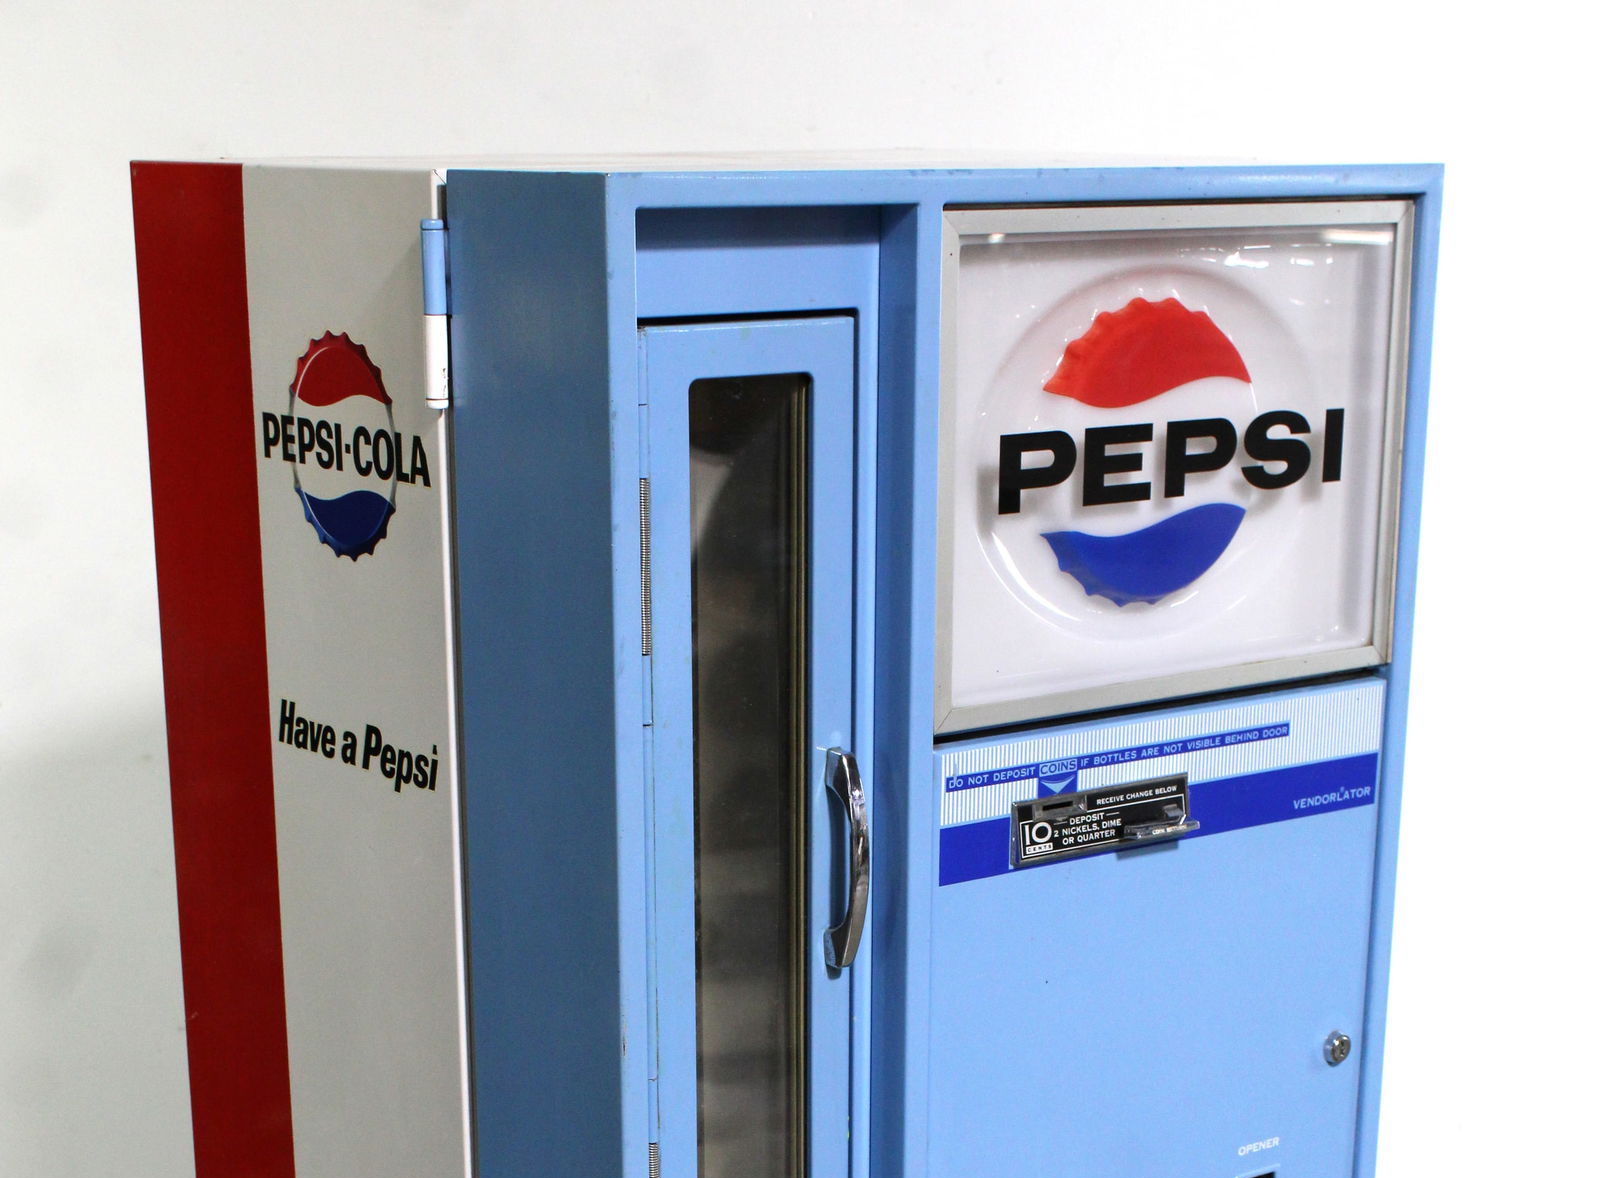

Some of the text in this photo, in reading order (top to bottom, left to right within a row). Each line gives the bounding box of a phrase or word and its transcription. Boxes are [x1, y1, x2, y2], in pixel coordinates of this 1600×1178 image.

[999, 408, 1345, 515] PEPSI
[278, 698, 439, 793] Have a Pepsi
[949, 726, 1288, 789] DO NOT DEPOSIT COINS IF BOTTLES ARE NOT VISIBLE BEHIND DOOR
[1096, 785, 1178, 806] RECEIVE CHANGE BELOW
[1293, 786, 1371, 810] VENDORLATOR
[1054, 830, 1060, 838] 2
[1102, 818, 1122, 830] DIME
[1069, 812, 1105, 825] DEPOSIT
[1024, 821, 1052, 846] 10
[1062, 829, 1116, 846] OR QUARTER
[1238, 1136, 1280, 1156] OPENER
